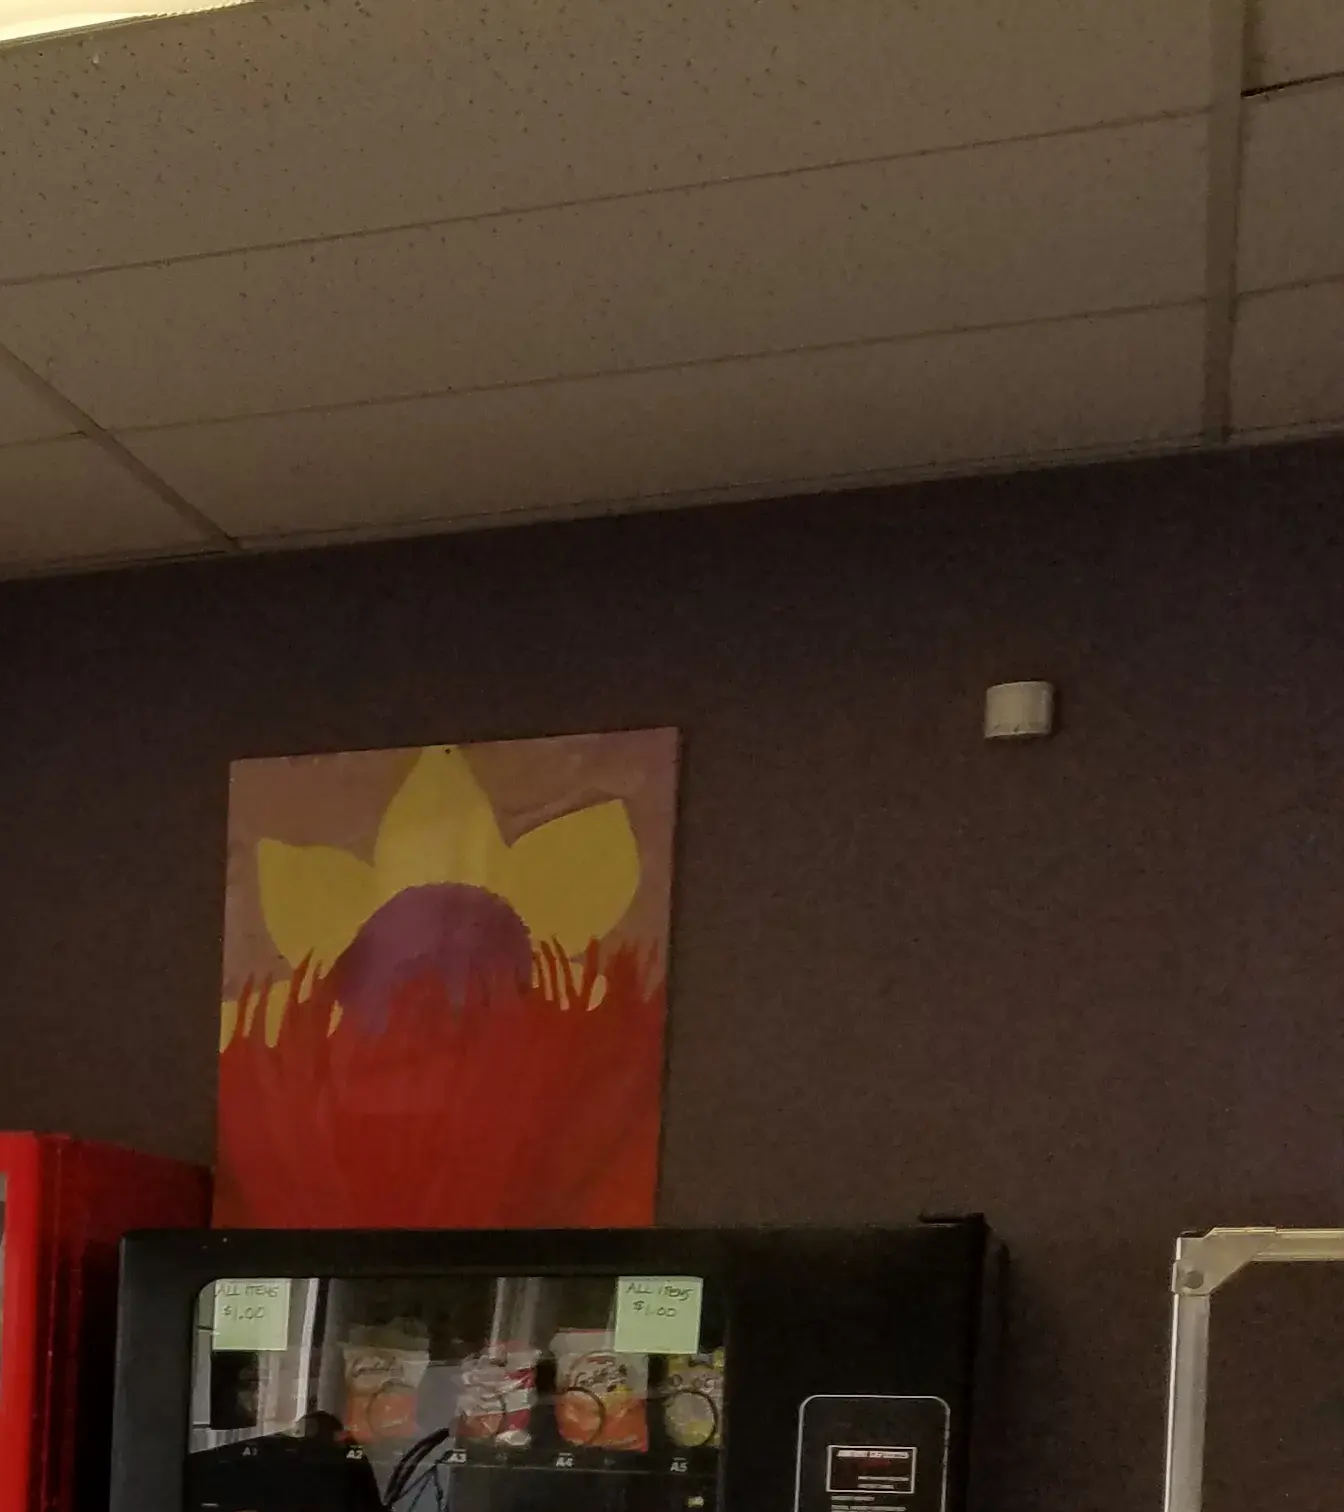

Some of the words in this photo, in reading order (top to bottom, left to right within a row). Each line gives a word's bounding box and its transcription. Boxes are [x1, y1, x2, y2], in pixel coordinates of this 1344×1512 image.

[346, 1448, 363, 1459] A2
[450, 1452, 468, 1464] A3
[556, 1456, 575, 1468] A4
[670, 1461, 688, 1473] A5
